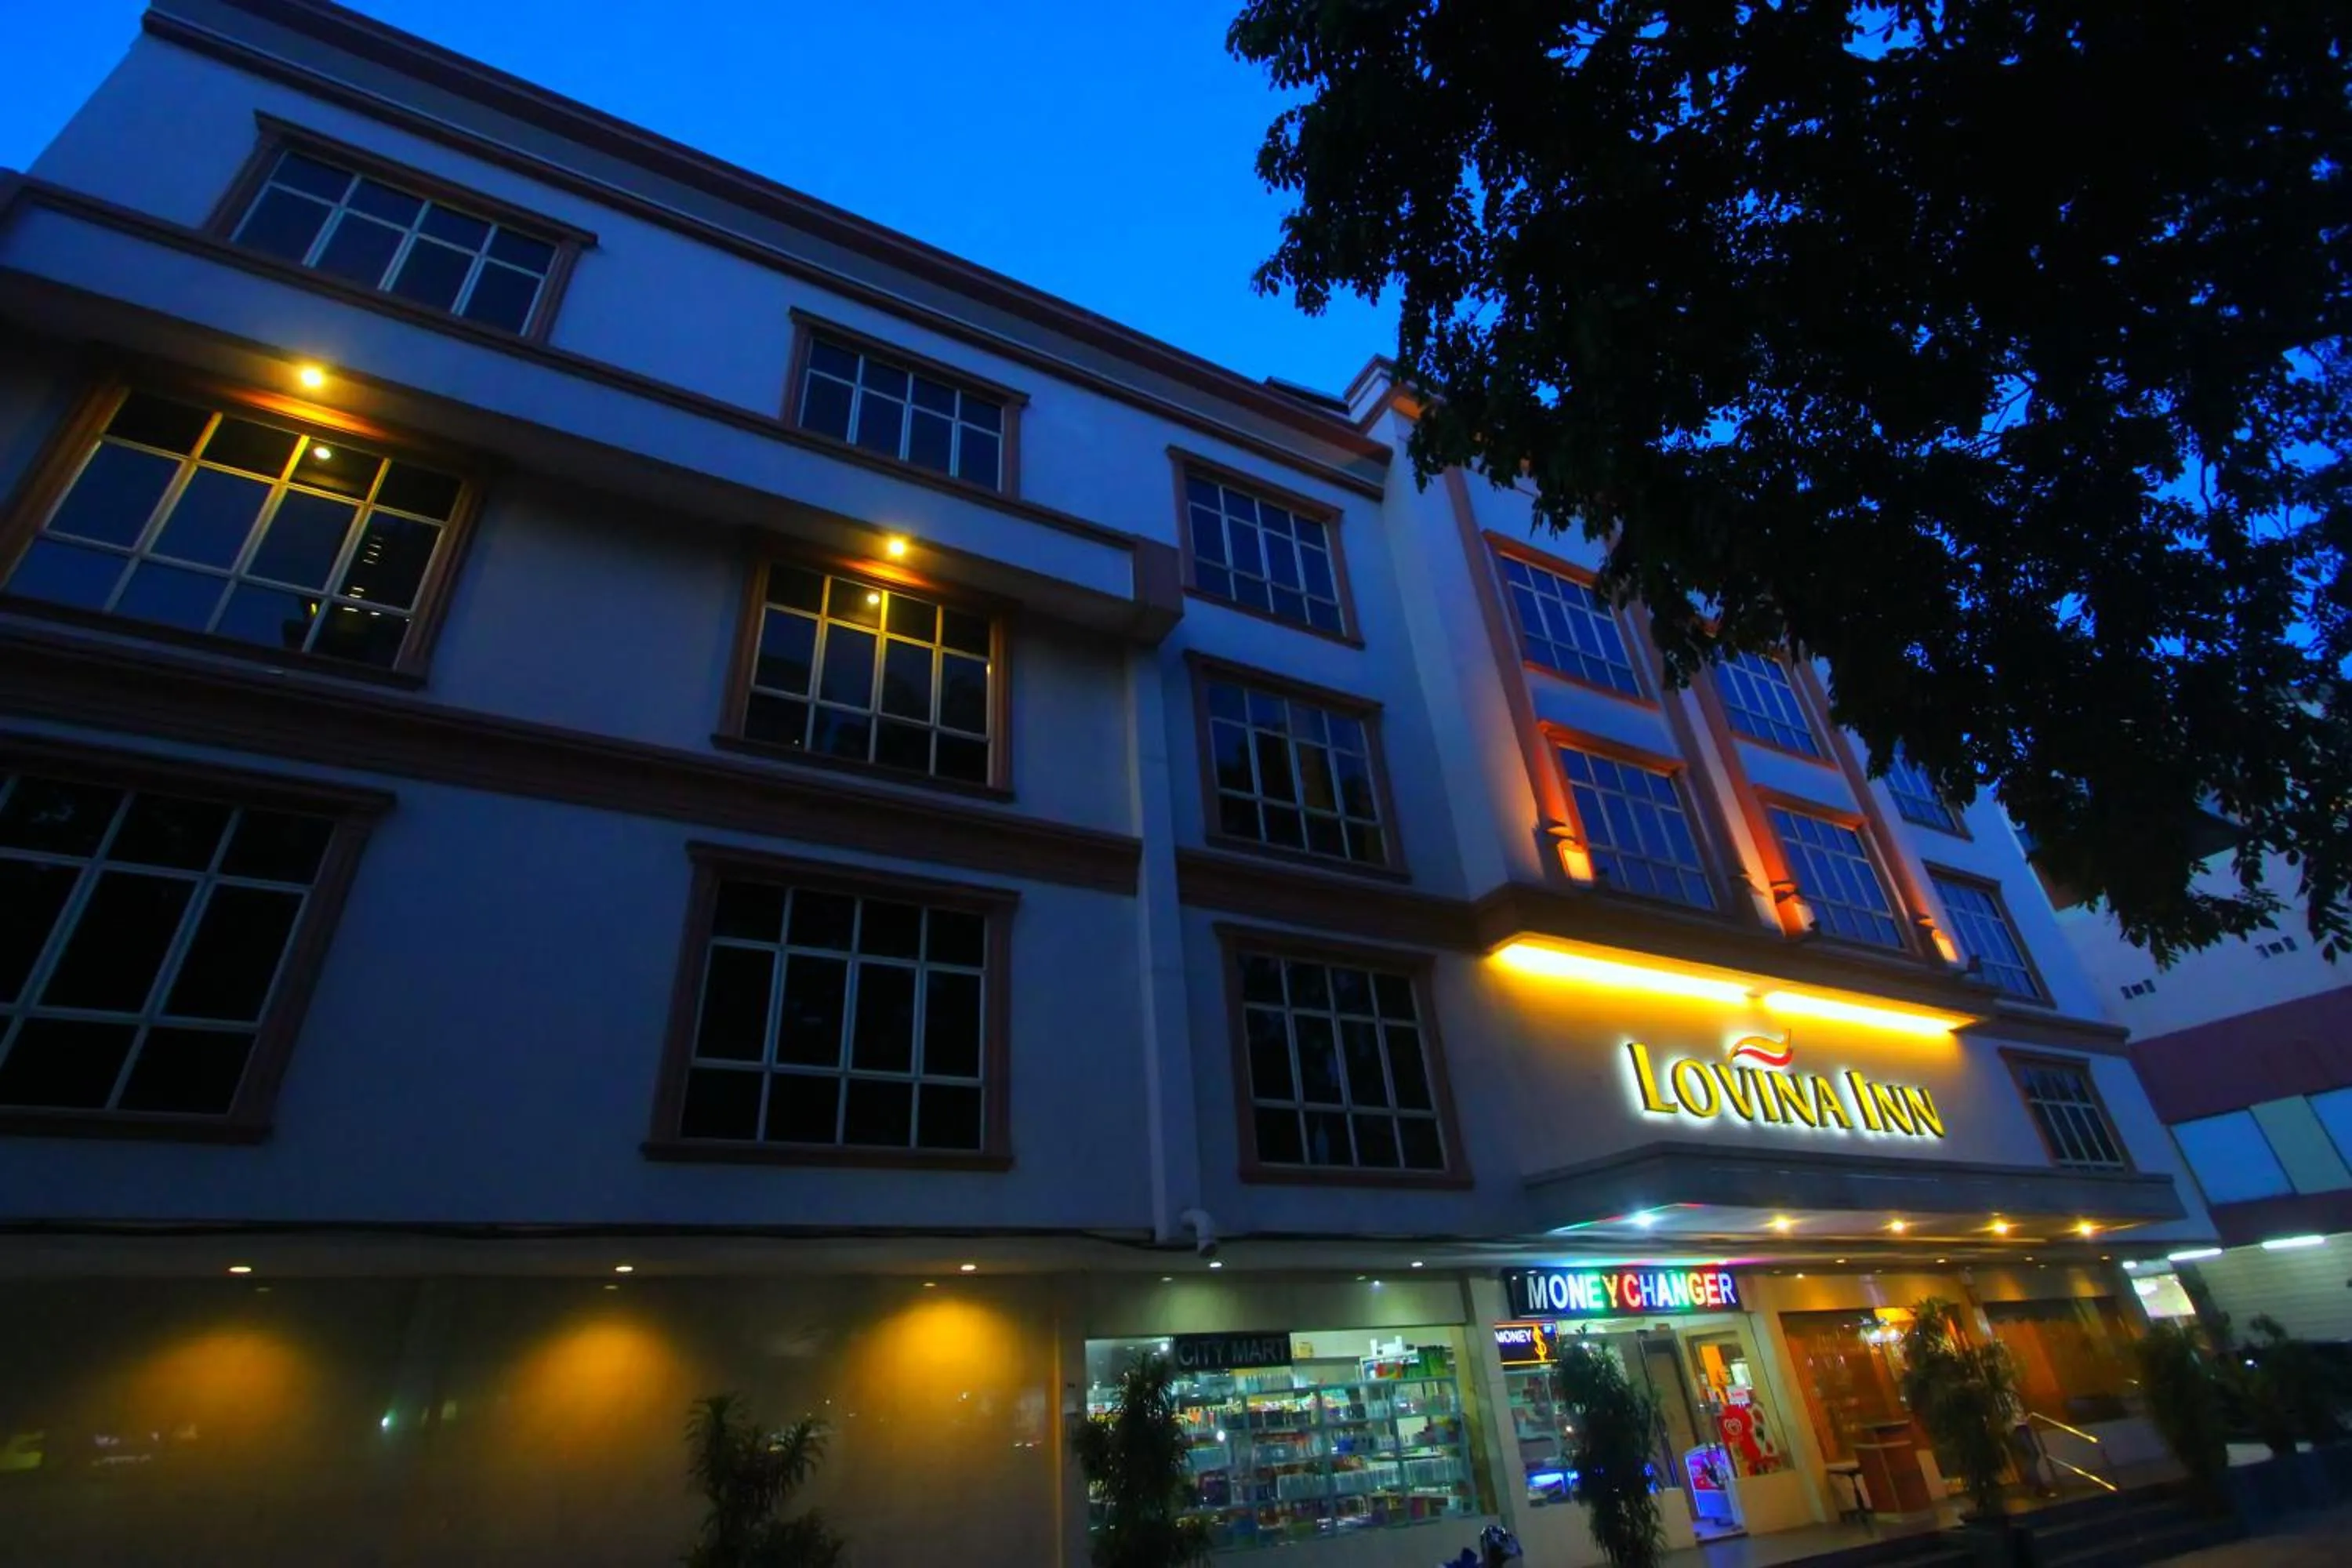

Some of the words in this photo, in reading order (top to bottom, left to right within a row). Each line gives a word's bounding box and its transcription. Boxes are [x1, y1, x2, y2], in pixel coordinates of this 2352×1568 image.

[1628, 1042, 1853, 1128] LOVINA
[1845, 1070, 1944, 1138] INN
[1528, 1273, 1618, 1310] MONEY
[1623, 1272, 1737, 1312] CHANGER
[1178, 1341, 1225, 1366] CITY
[1232, 1338, 1287, 1363] MART
[1494, 1330, 1531, 1342] MONEY
